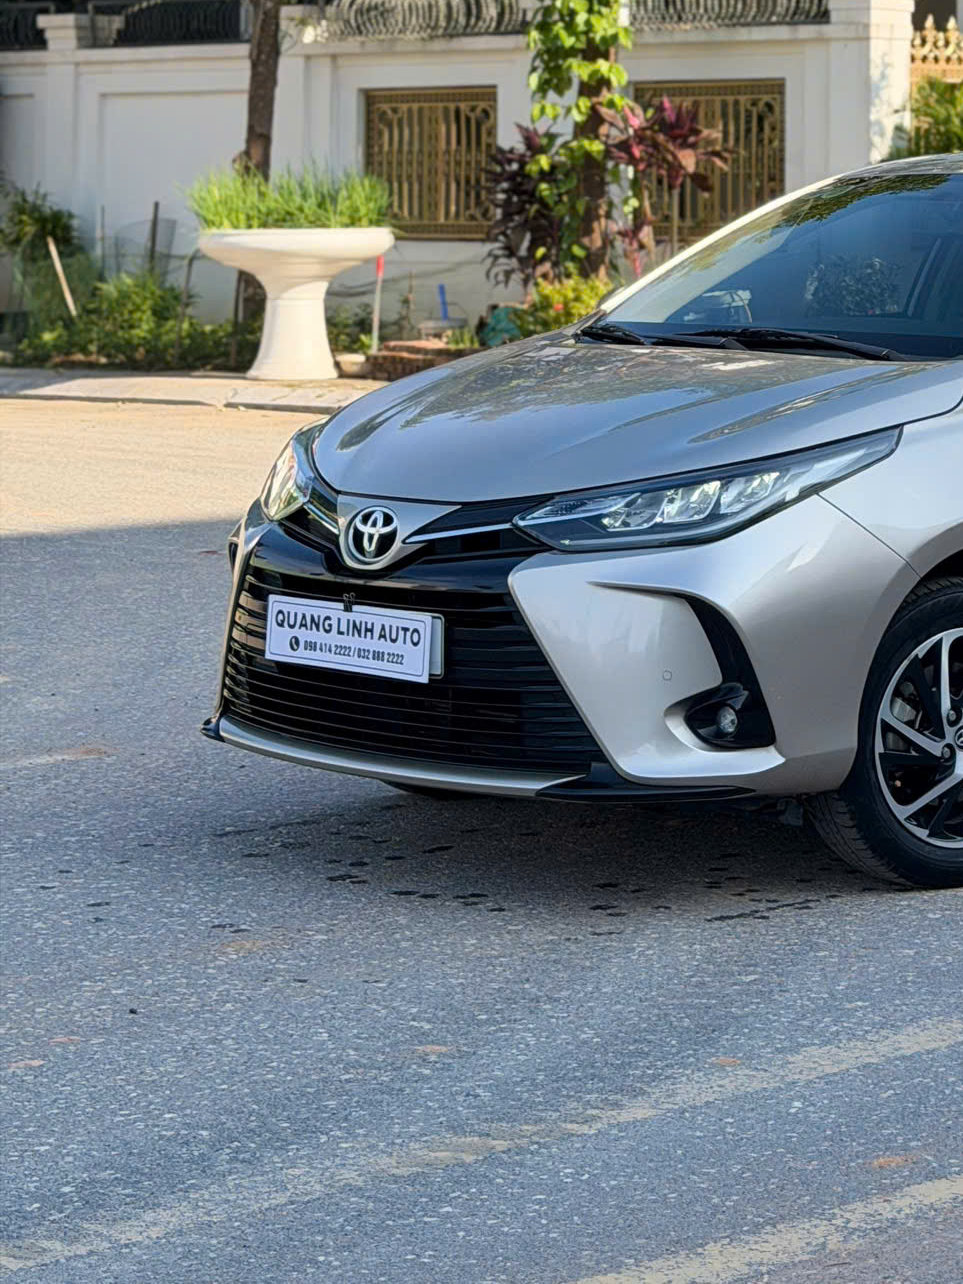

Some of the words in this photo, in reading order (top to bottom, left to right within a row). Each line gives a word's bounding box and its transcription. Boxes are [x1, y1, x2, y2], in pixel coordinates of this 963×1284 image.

[275, 609, 333, 634] QUANG
[337, 617, 375, 640] LINH
[377, 623, 421, 647] AUTO
[303, 639, 318, 652] 098
[318, 641, 332, 654] 414
[333, 644, 352, 657] 2222
[356, 647, 370, 660] 032
[386, 651, 405, 665] 2222
